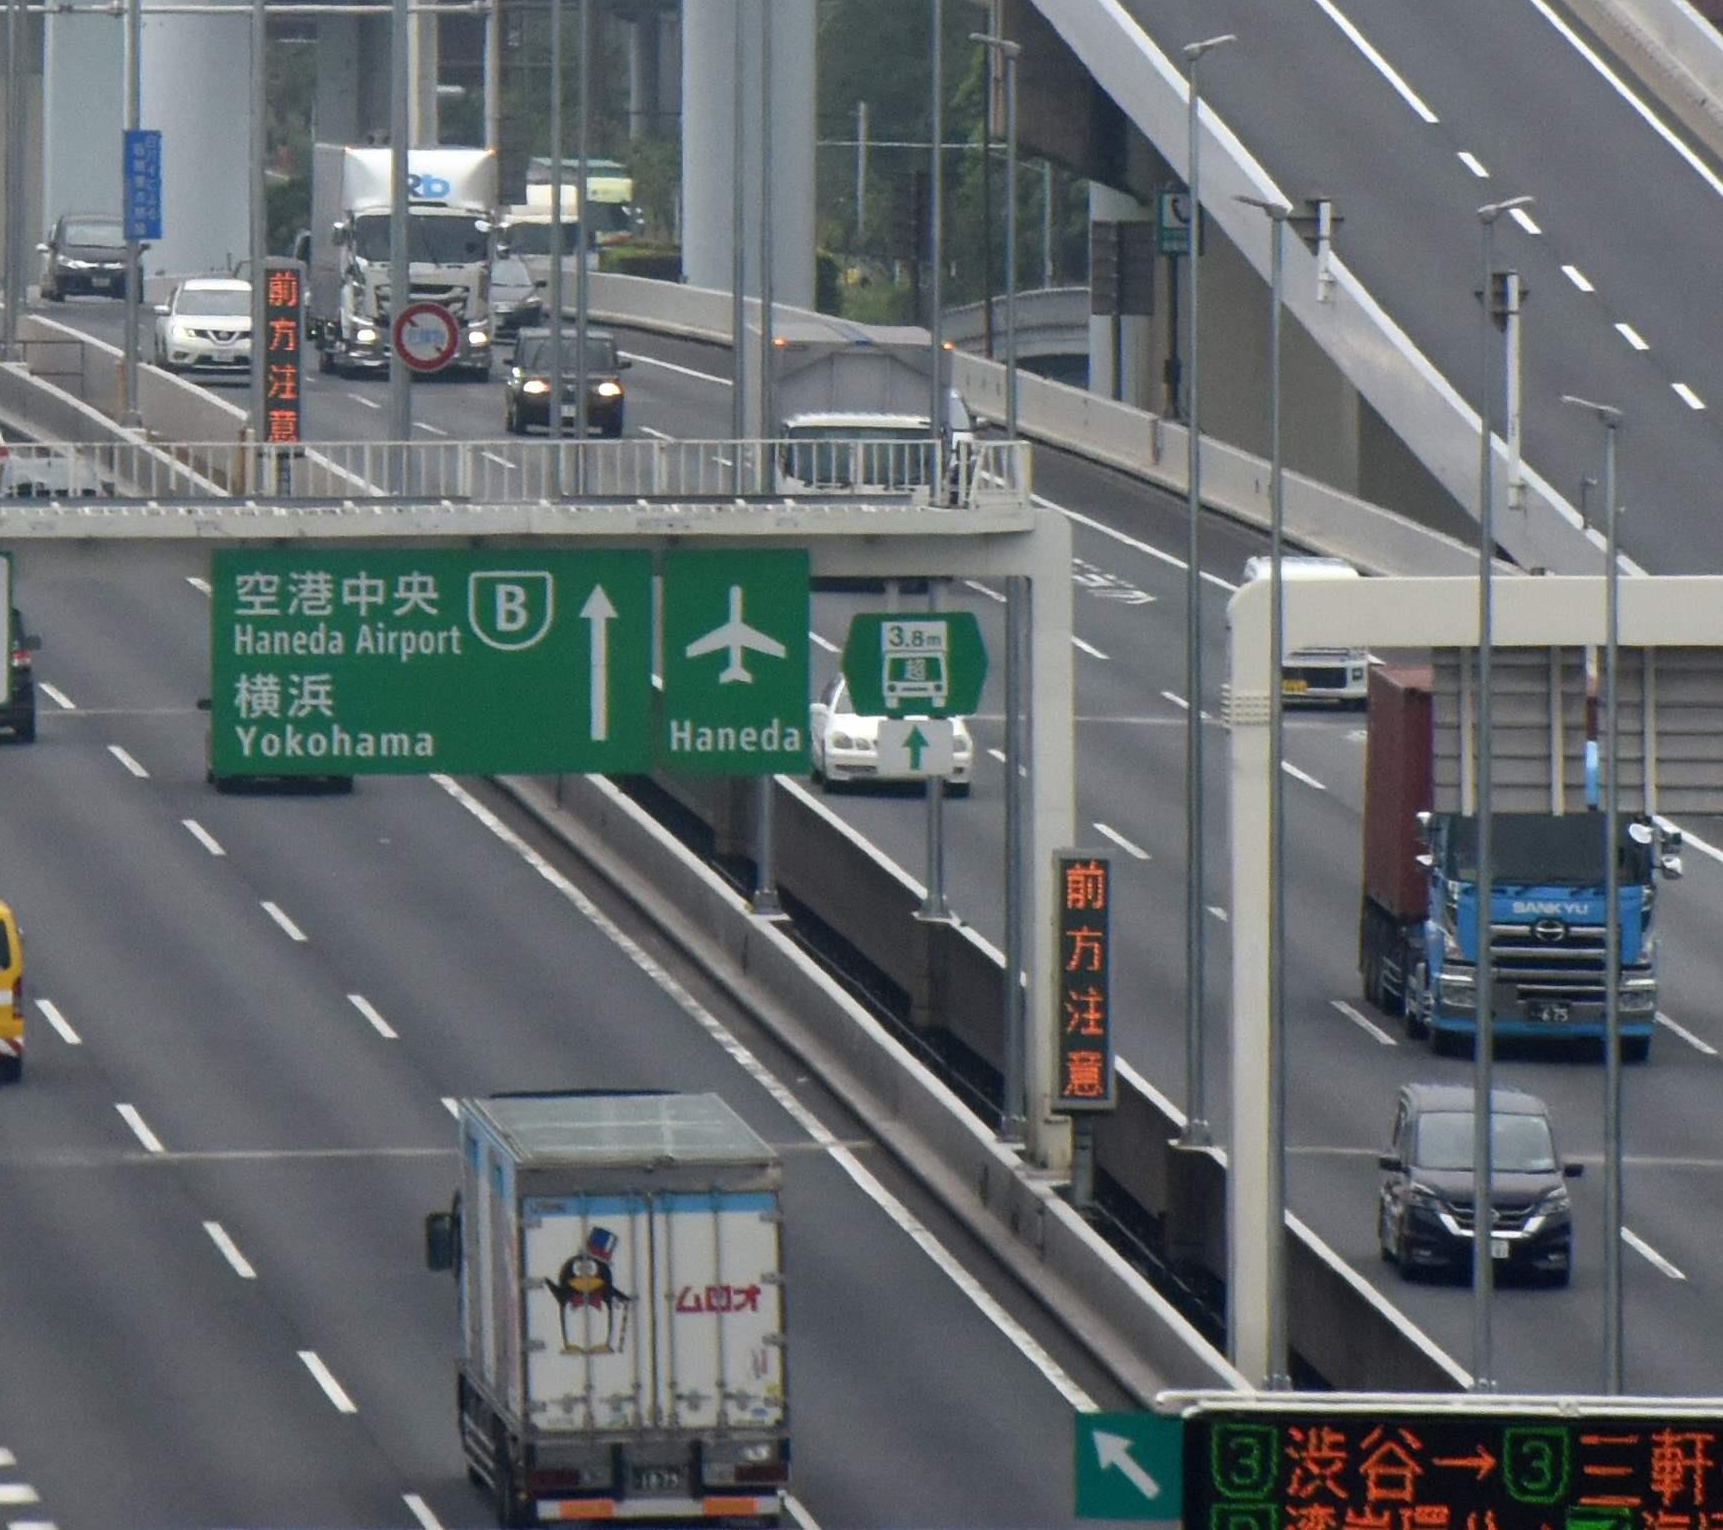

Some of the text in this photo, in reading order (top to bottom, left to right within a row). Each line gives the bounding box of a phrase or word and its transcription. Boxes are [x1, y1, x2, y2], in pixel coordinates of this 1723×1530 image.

[267, 270, 299, 442] 前方注意
[234, 571, 439, 617] 空港中央
[495, 583, 528, 632] B
[233, 622, 462, 663] Haneda Airport
[234, 673, 333, 719] 横浜
[235, 723, 435, 758] Yokohama
[669, 719, 801, 752] Haneda
[1512, 901, 1589, 915] SANKYU
[1063, 858, 1105, 1097] 前方注意
[1227, 1424, 1716, 1506] 3 渋谷 3 三軒
